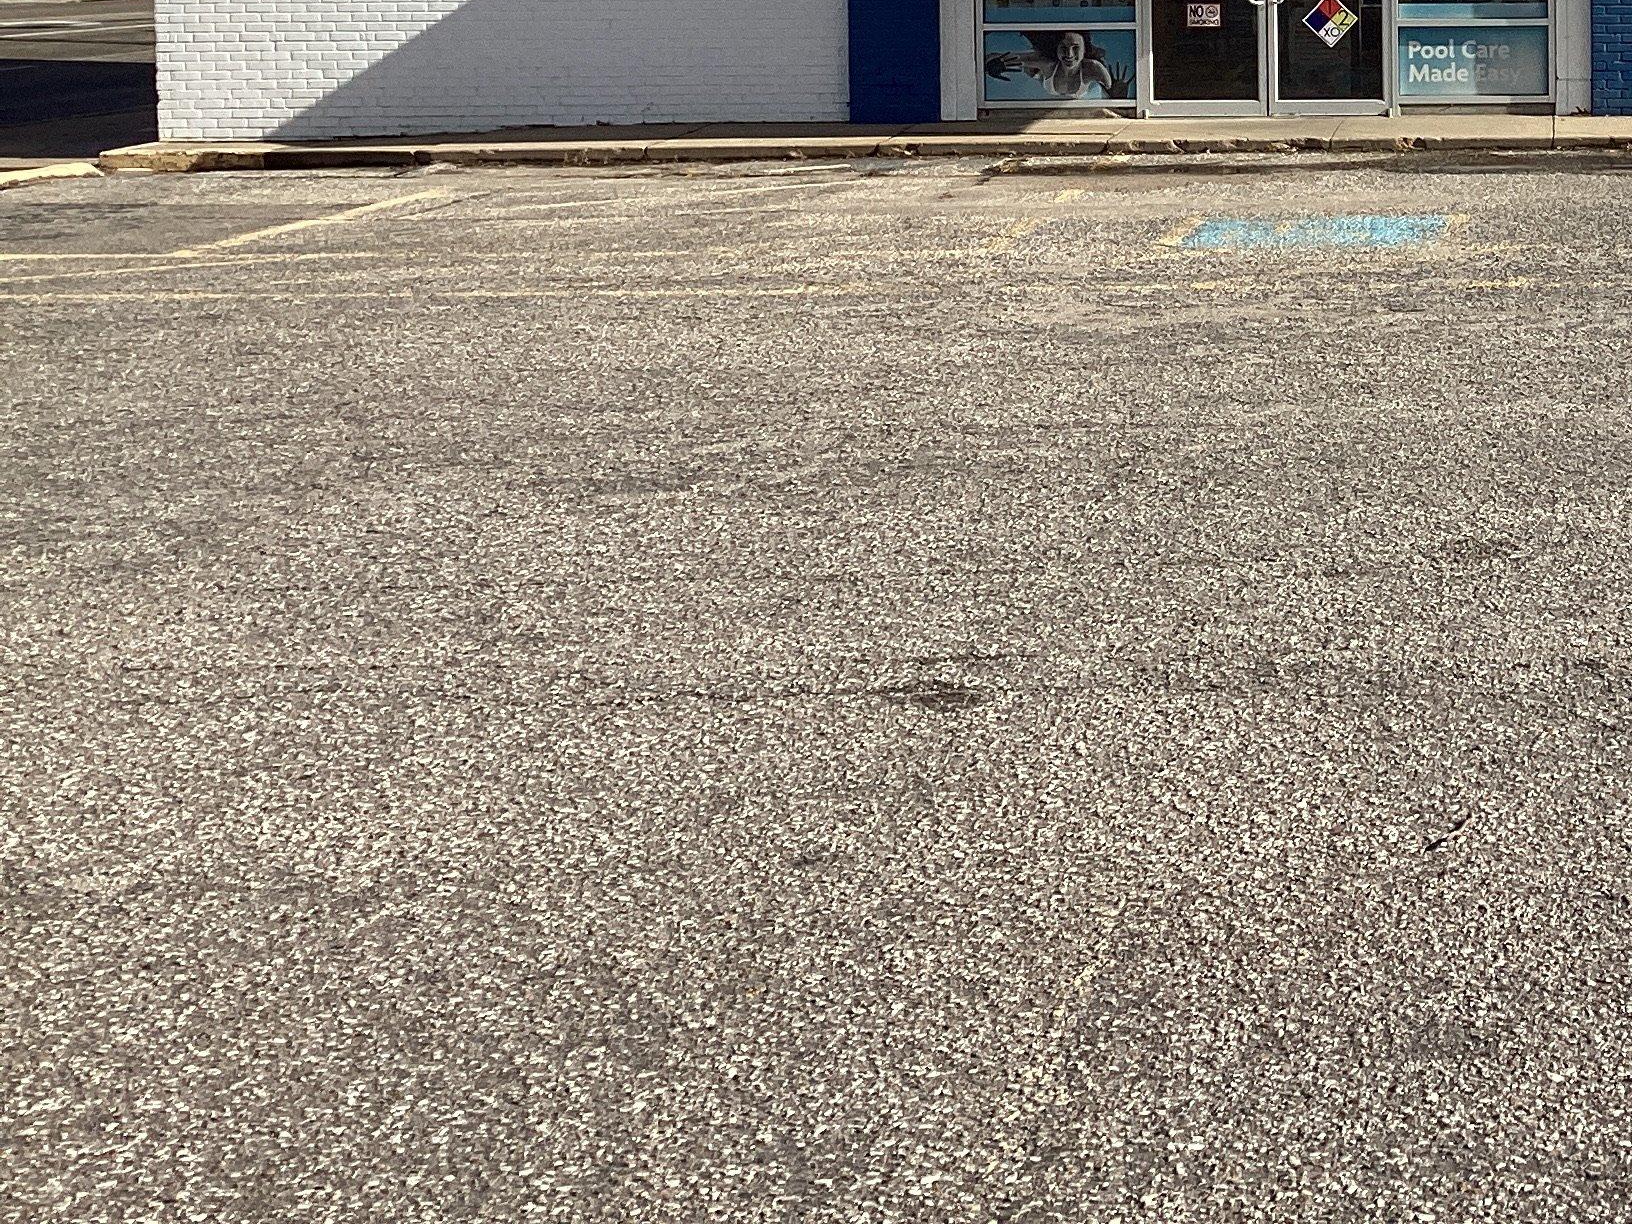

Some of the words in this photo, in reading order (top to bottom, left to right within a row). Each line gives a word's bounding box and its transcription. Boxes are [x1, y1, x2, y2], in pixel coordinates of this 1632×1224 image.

[1189, 4, 1204, 18] NO
[1338, 8, 1350, 27] 2
[1408, 39, 1456, 60] Pool
[1461, 39, 1511, 60] Care
[1408, 62, 1469, 83] Made
